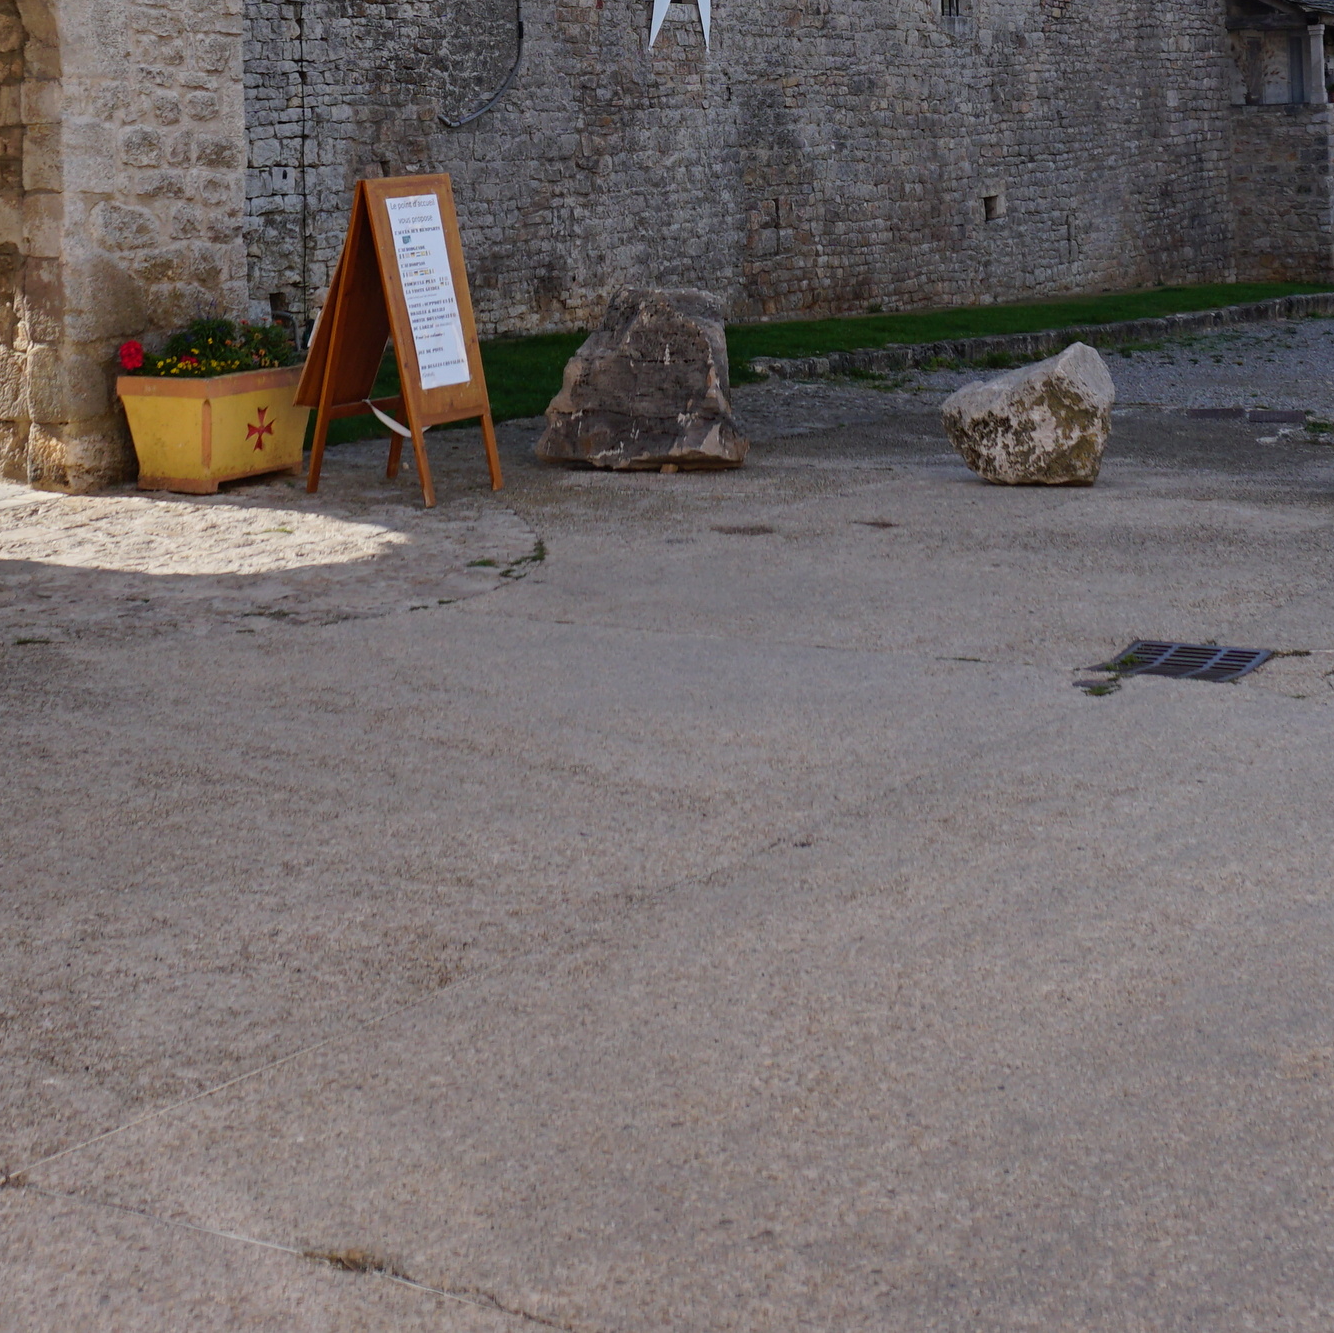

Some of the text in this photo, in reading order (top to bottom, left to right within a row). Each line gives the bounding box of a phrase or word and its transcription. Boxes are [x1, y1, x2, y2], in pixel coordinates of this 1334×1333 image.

[397, 200, 412, 210] point
[398, 215, 433, 224] vous propose
